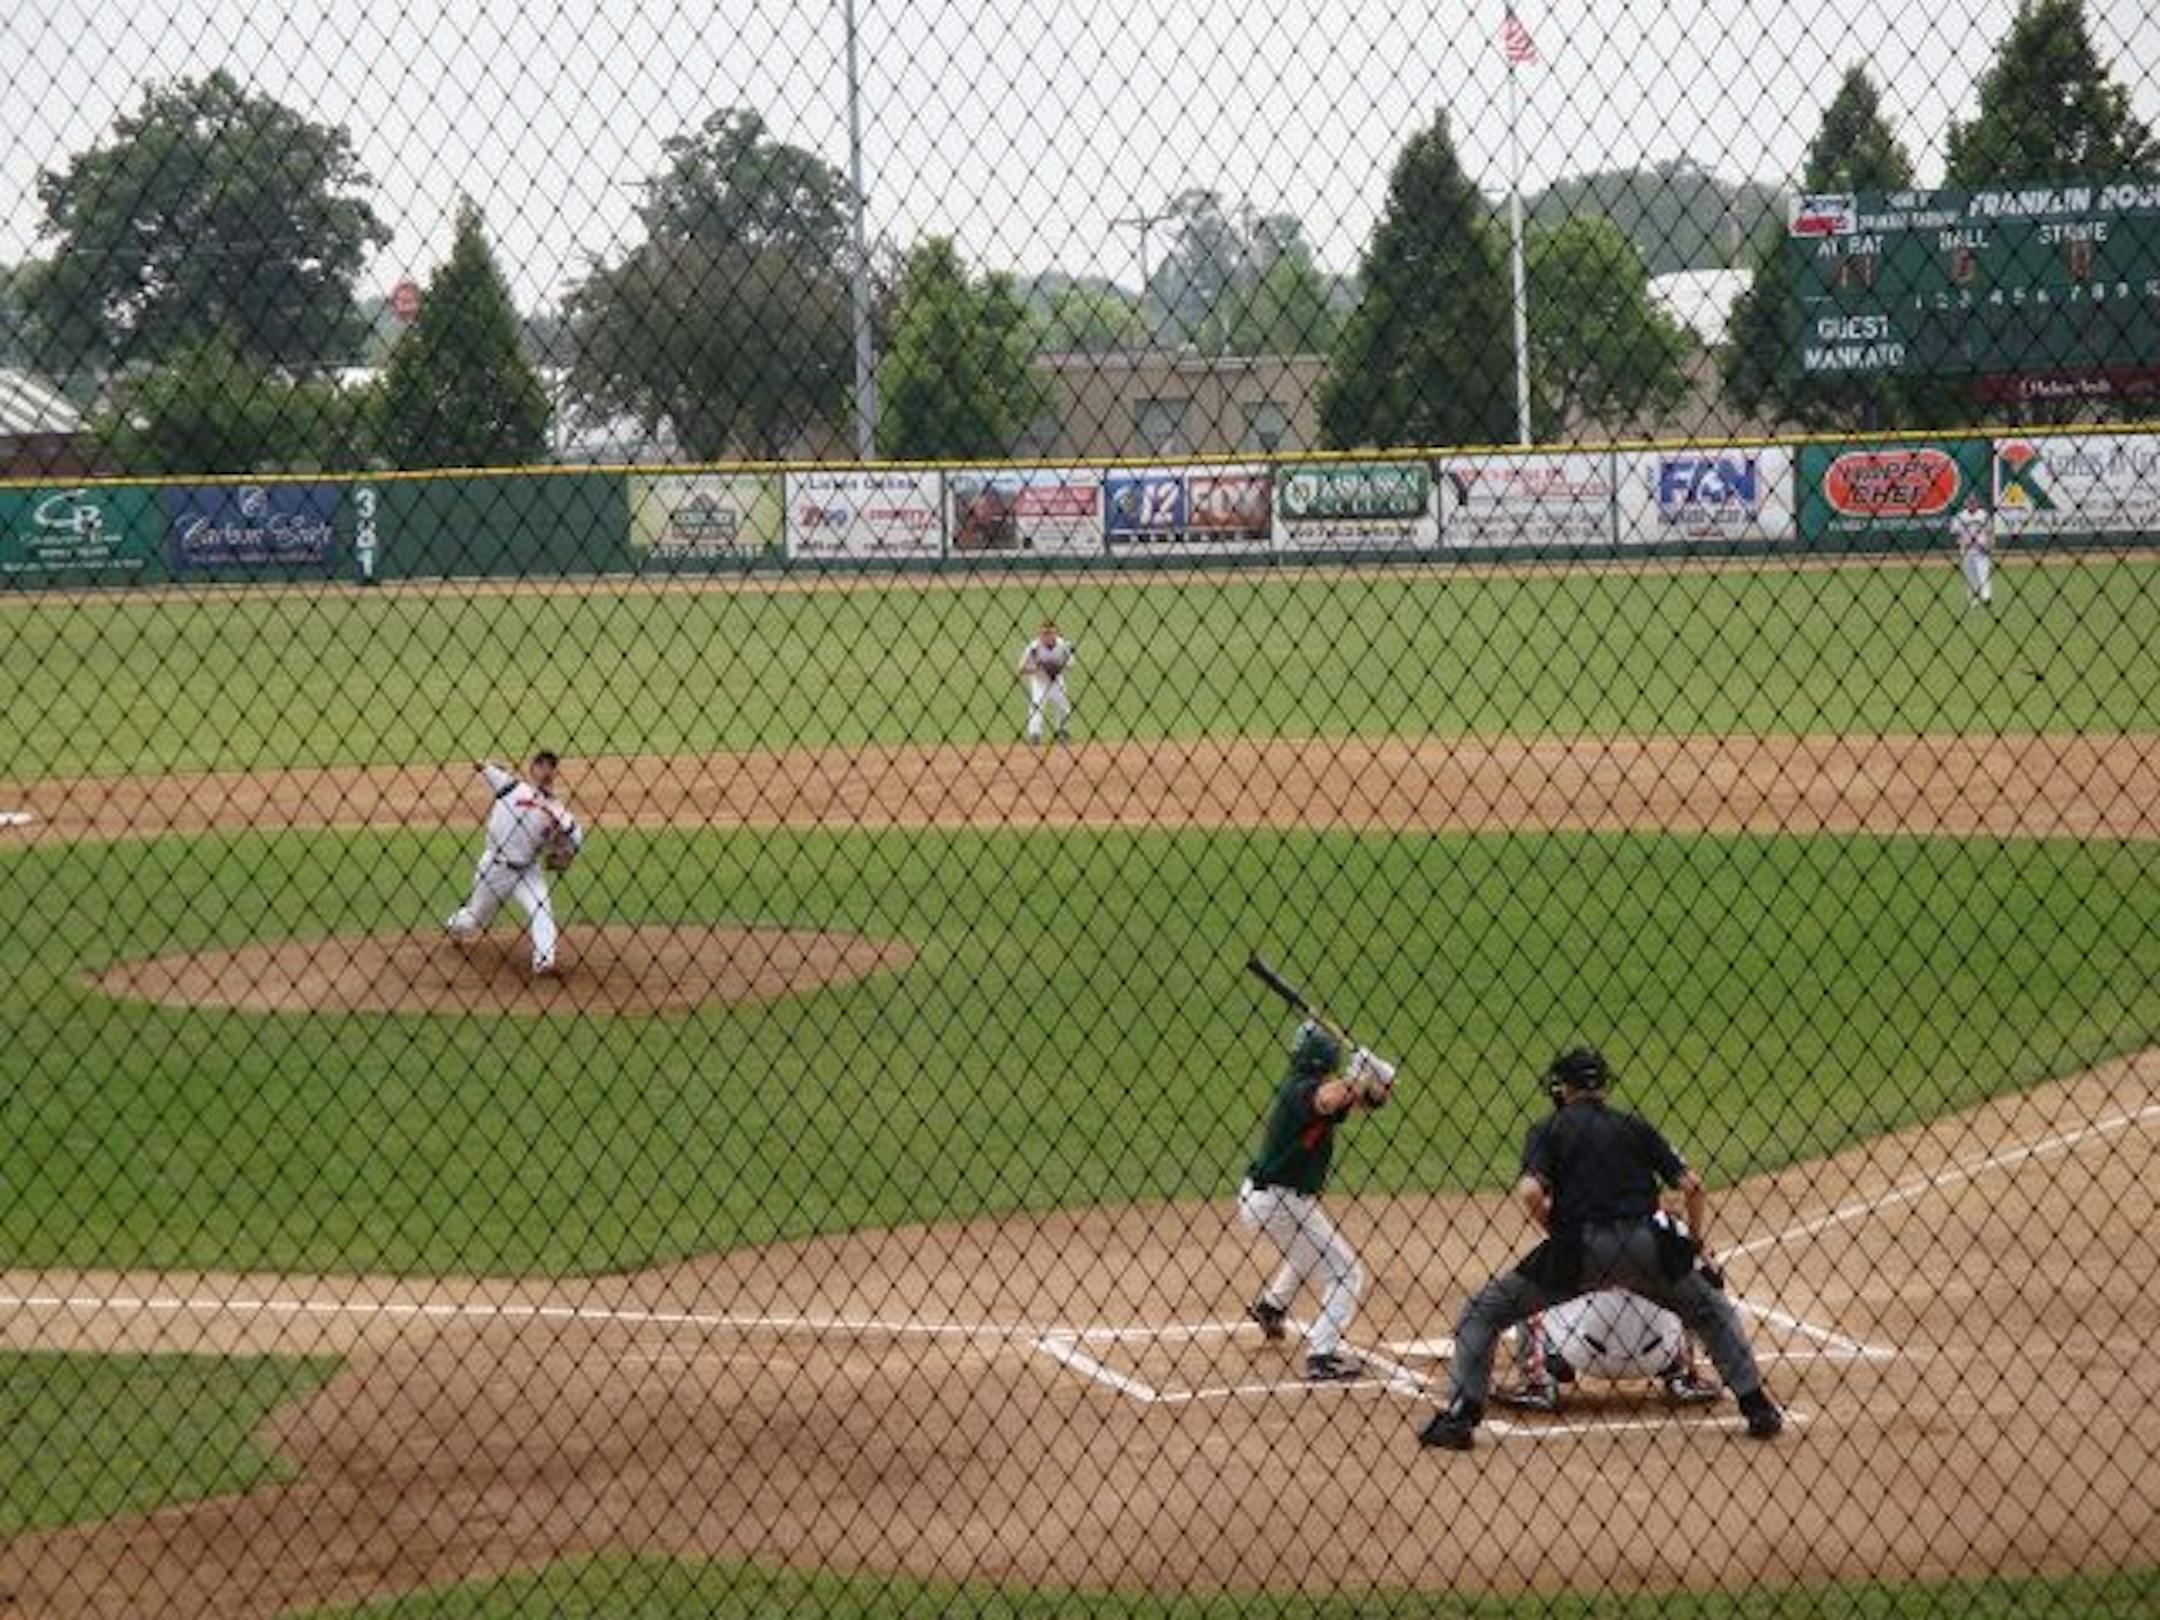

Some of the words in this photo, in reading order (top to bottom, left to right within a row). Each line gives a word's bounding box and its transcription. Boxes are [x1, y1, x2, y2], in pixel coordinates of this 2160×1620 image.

[1969, 187, 2091, 217] FRANKLIN
[1939, 228, 1989, 250] BALL
[1817, 315, 1889, 339] GUEST
[1804, 343, 1905, 370] MANKATO
